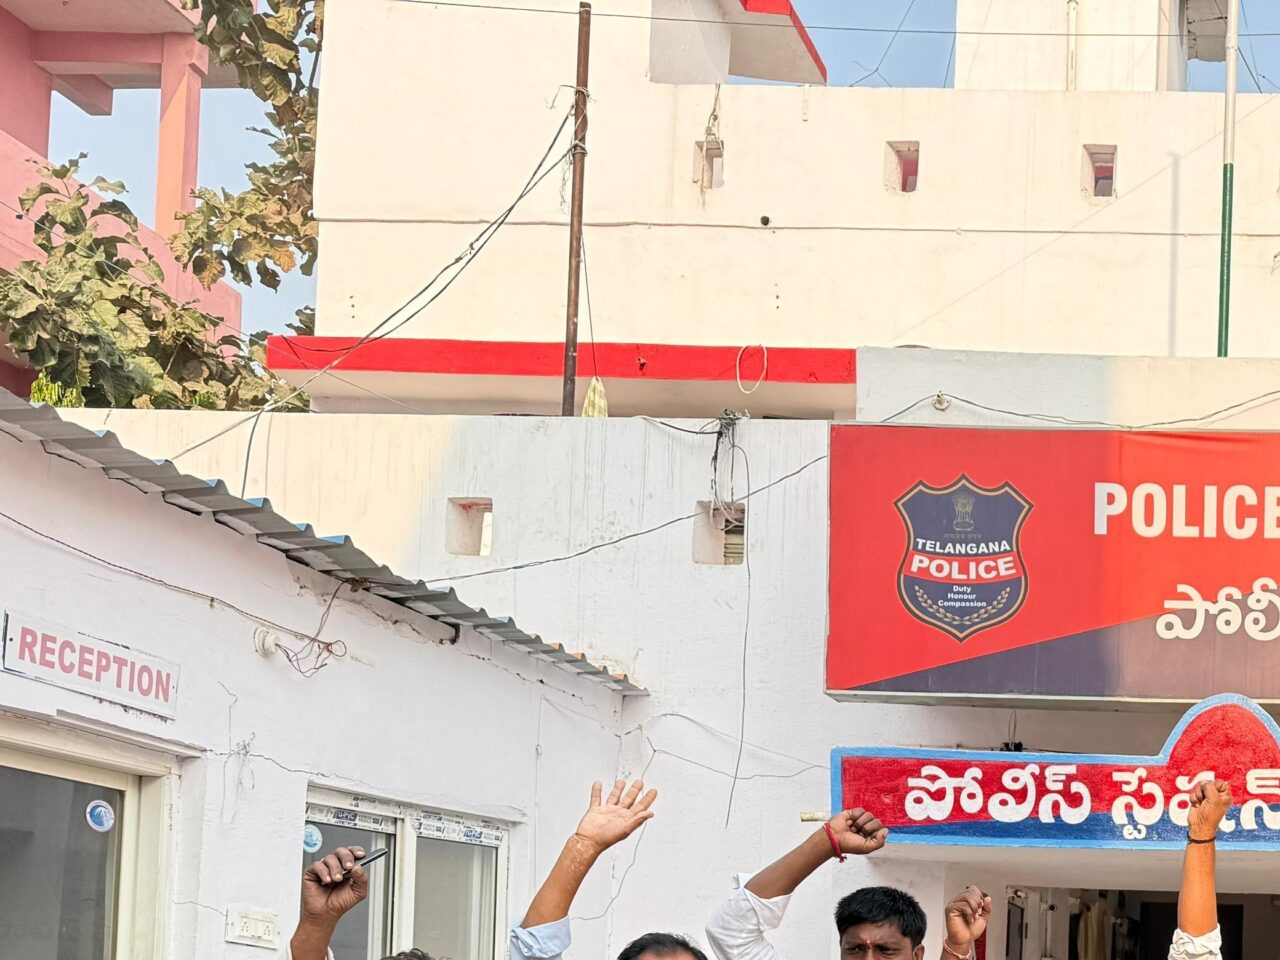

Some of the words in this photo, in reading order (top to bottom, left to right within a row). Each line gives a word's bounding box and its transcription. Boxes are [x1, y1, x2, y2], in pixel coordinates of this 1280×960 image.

[916, 538, 1011, 554] TELANGANA
[910, 555, 1016, 579] POLICE
[953, 585, 972, 594] Duty
[938, 600, 987, 608] Compassion
[18, 626, 171, 703] RECEPTION
